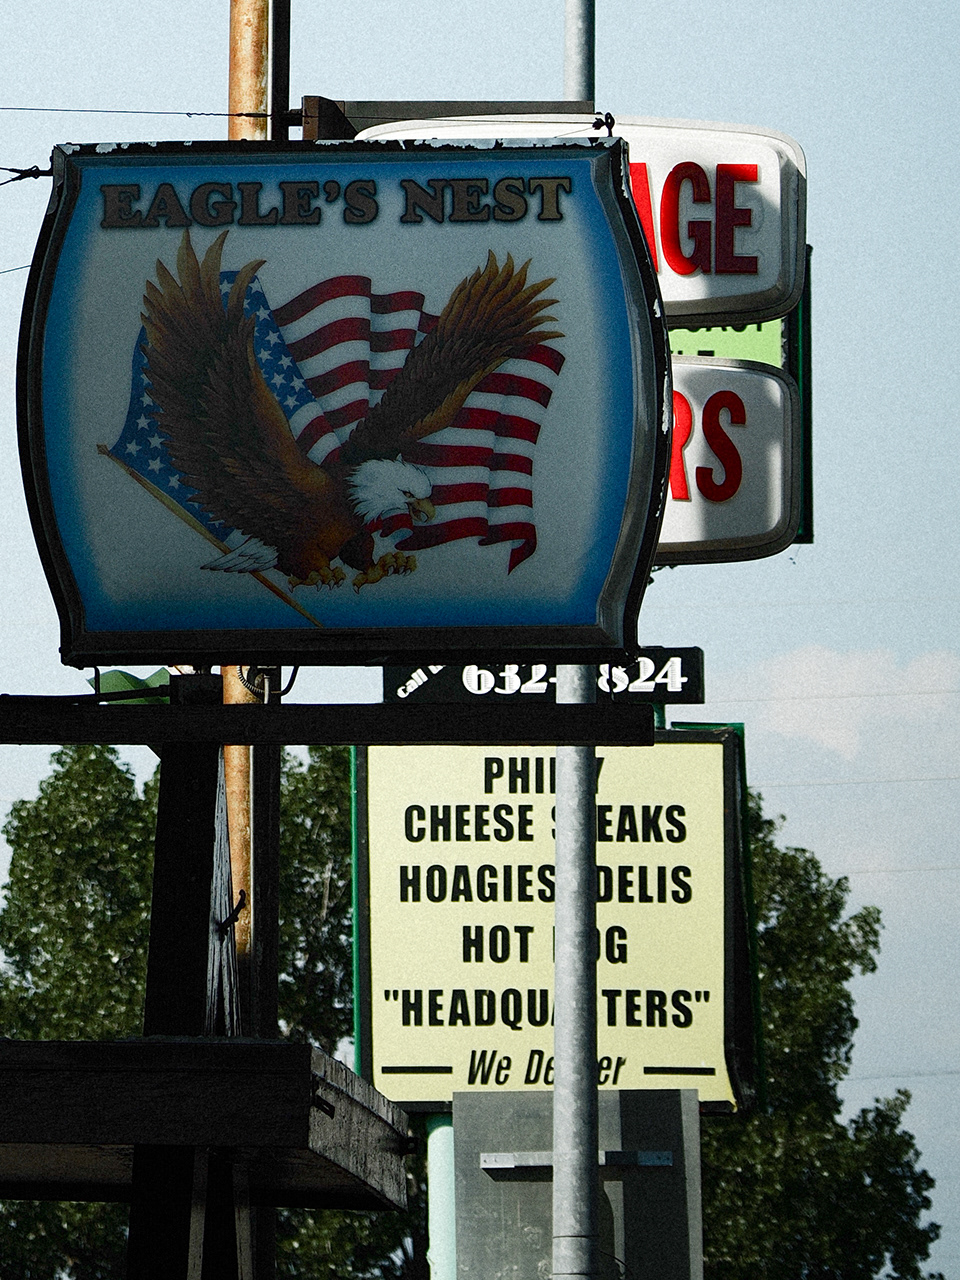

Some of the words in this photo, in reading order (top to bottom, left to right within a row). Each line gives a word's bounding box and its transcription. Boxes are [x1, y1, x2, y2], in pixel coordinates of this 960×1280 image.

[100, 180, 380, 228] EAGLE'S
[400, 177, 572, 224] NEST
[404, 804, 534, 842] CHEESE
[551, 804, 687, 843] EAKS
[399, 864, 556, 903] HOAGIES
[462, 925, 534, 963] HOT
[384, 988, 710, 1030] "HEADQUTERS"
[467, 1049, 512, 1085] We
[524, 1049, 627, 1085] Deer
